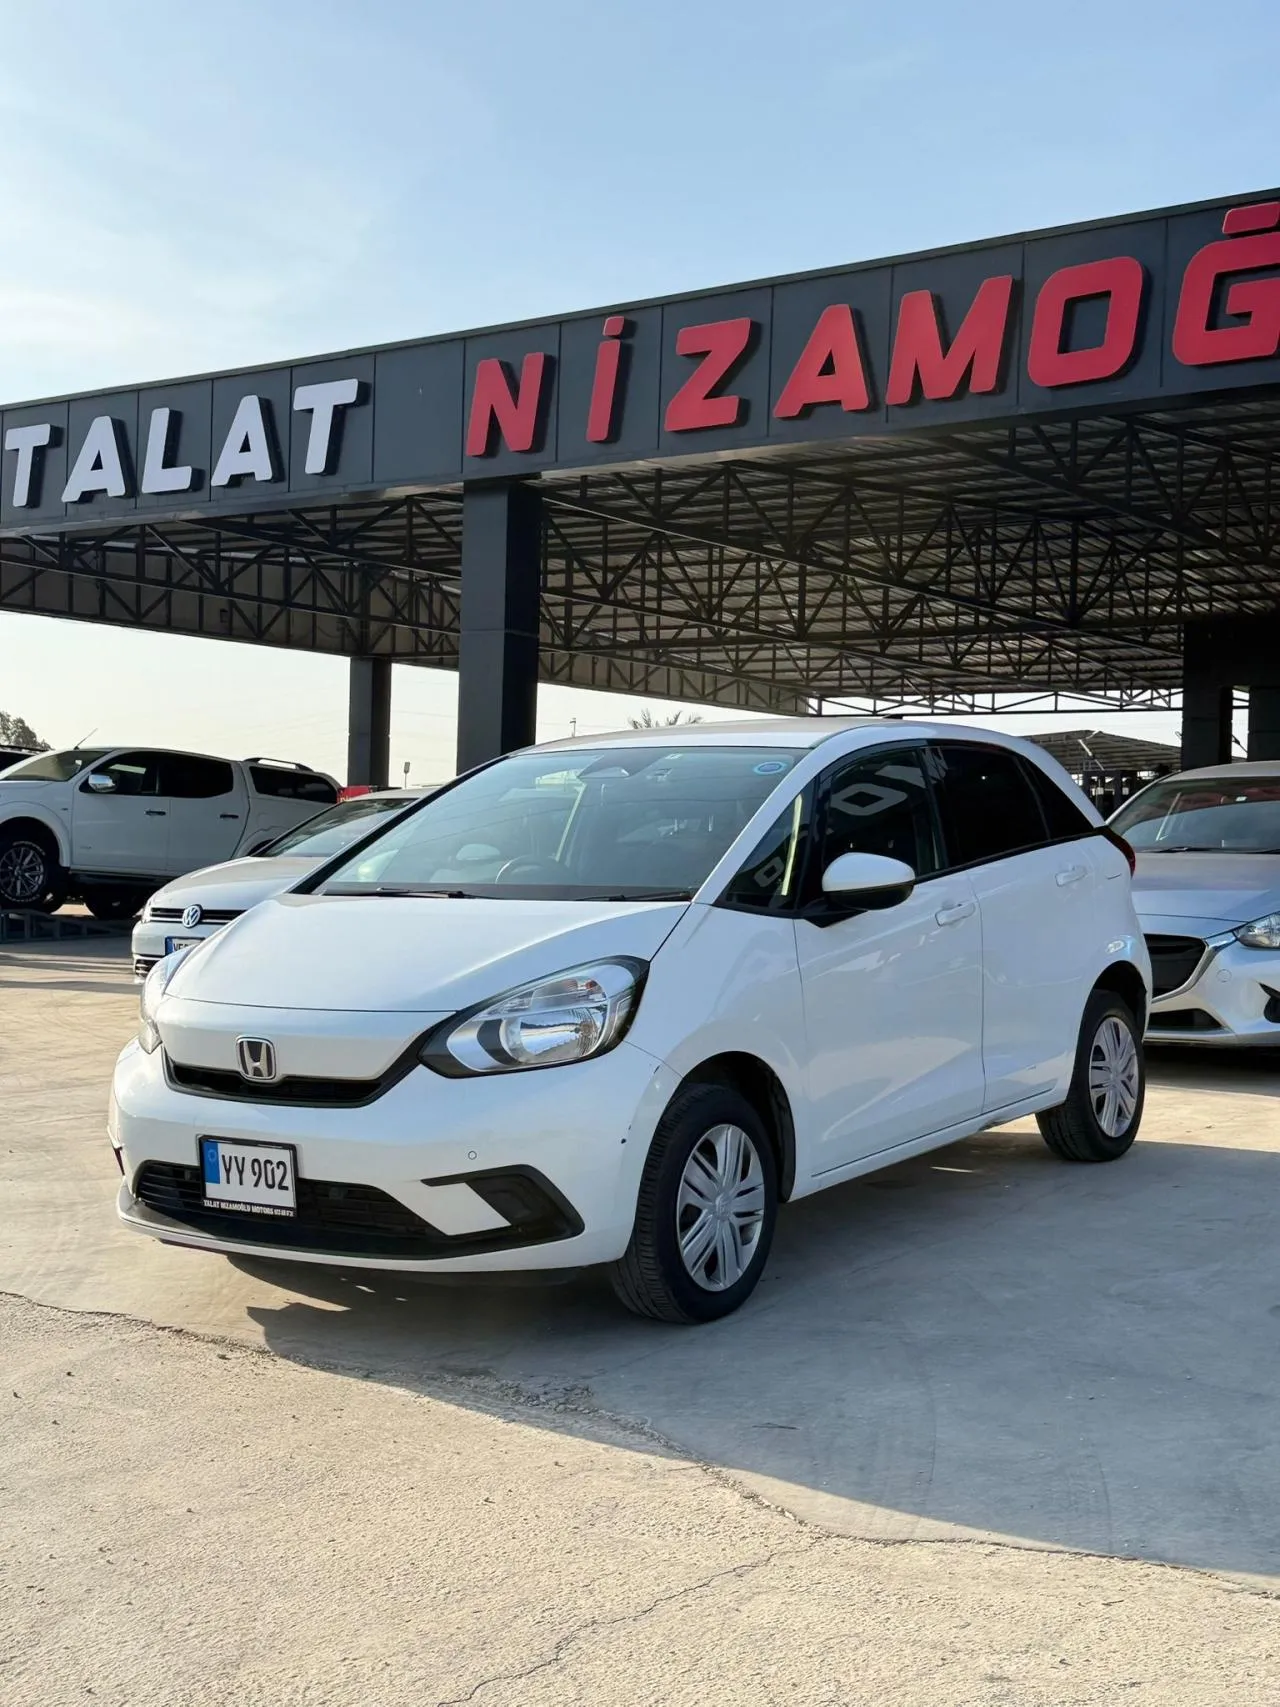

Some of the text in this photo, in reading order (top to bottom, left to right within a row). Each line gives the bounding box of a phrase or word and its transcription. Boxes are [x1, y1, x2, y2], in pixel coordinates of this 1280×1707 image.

[4, 201, 1280, 508] TALAT NİZAMOĞ
[221, 1154, 290, 1192] YY 902
